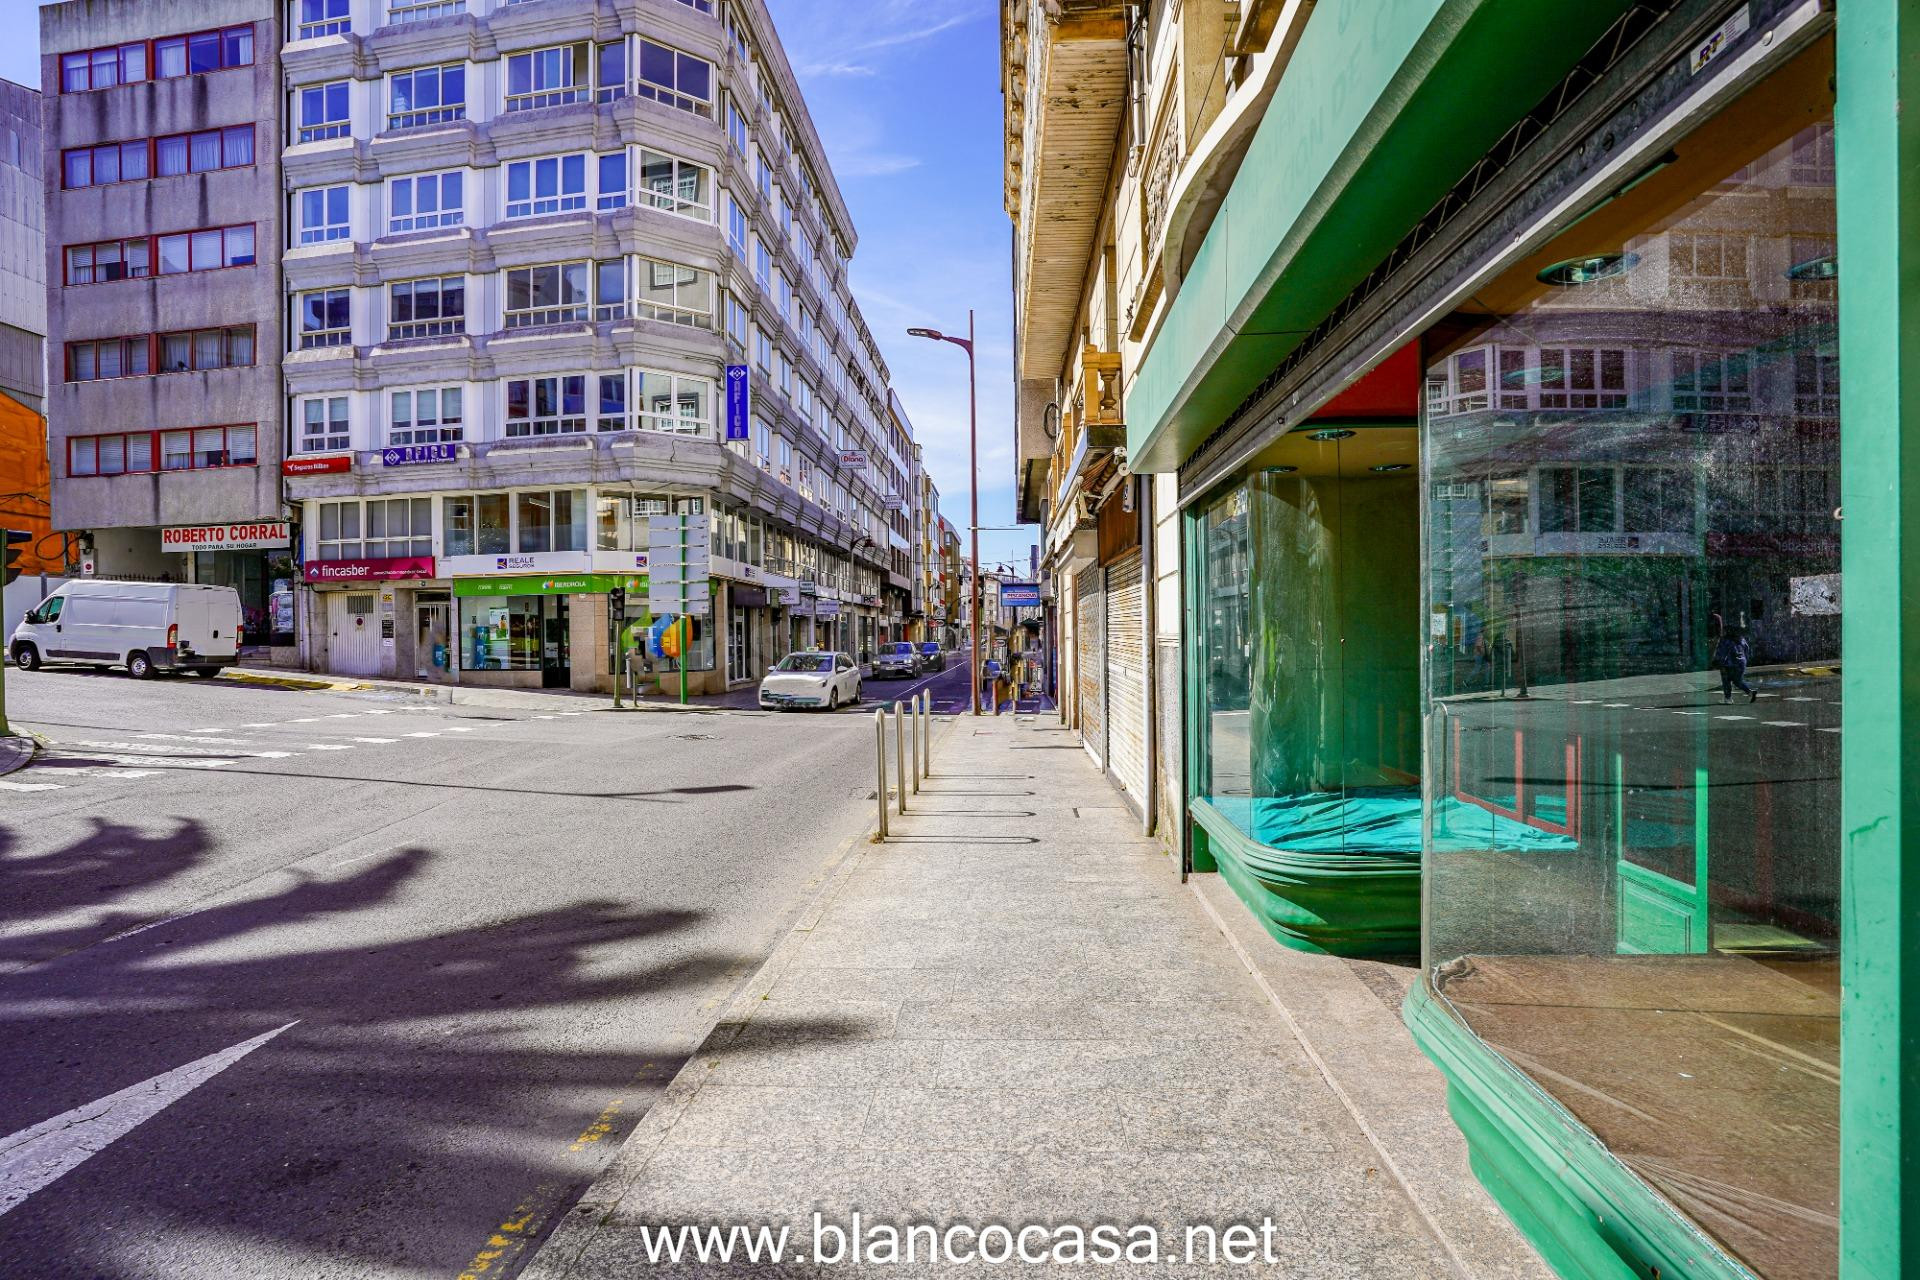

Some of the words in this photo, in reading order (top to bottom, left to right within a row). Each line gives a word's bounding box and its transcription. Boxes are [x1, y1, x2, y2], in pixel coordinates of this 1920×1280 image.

[163, 527, 225, 544] ROBERTO
[230, 523, 288, 541] CORRAL
[322, 564, 370, 577] fincasber
[554, 580, 586, 588] IBERDROLA
